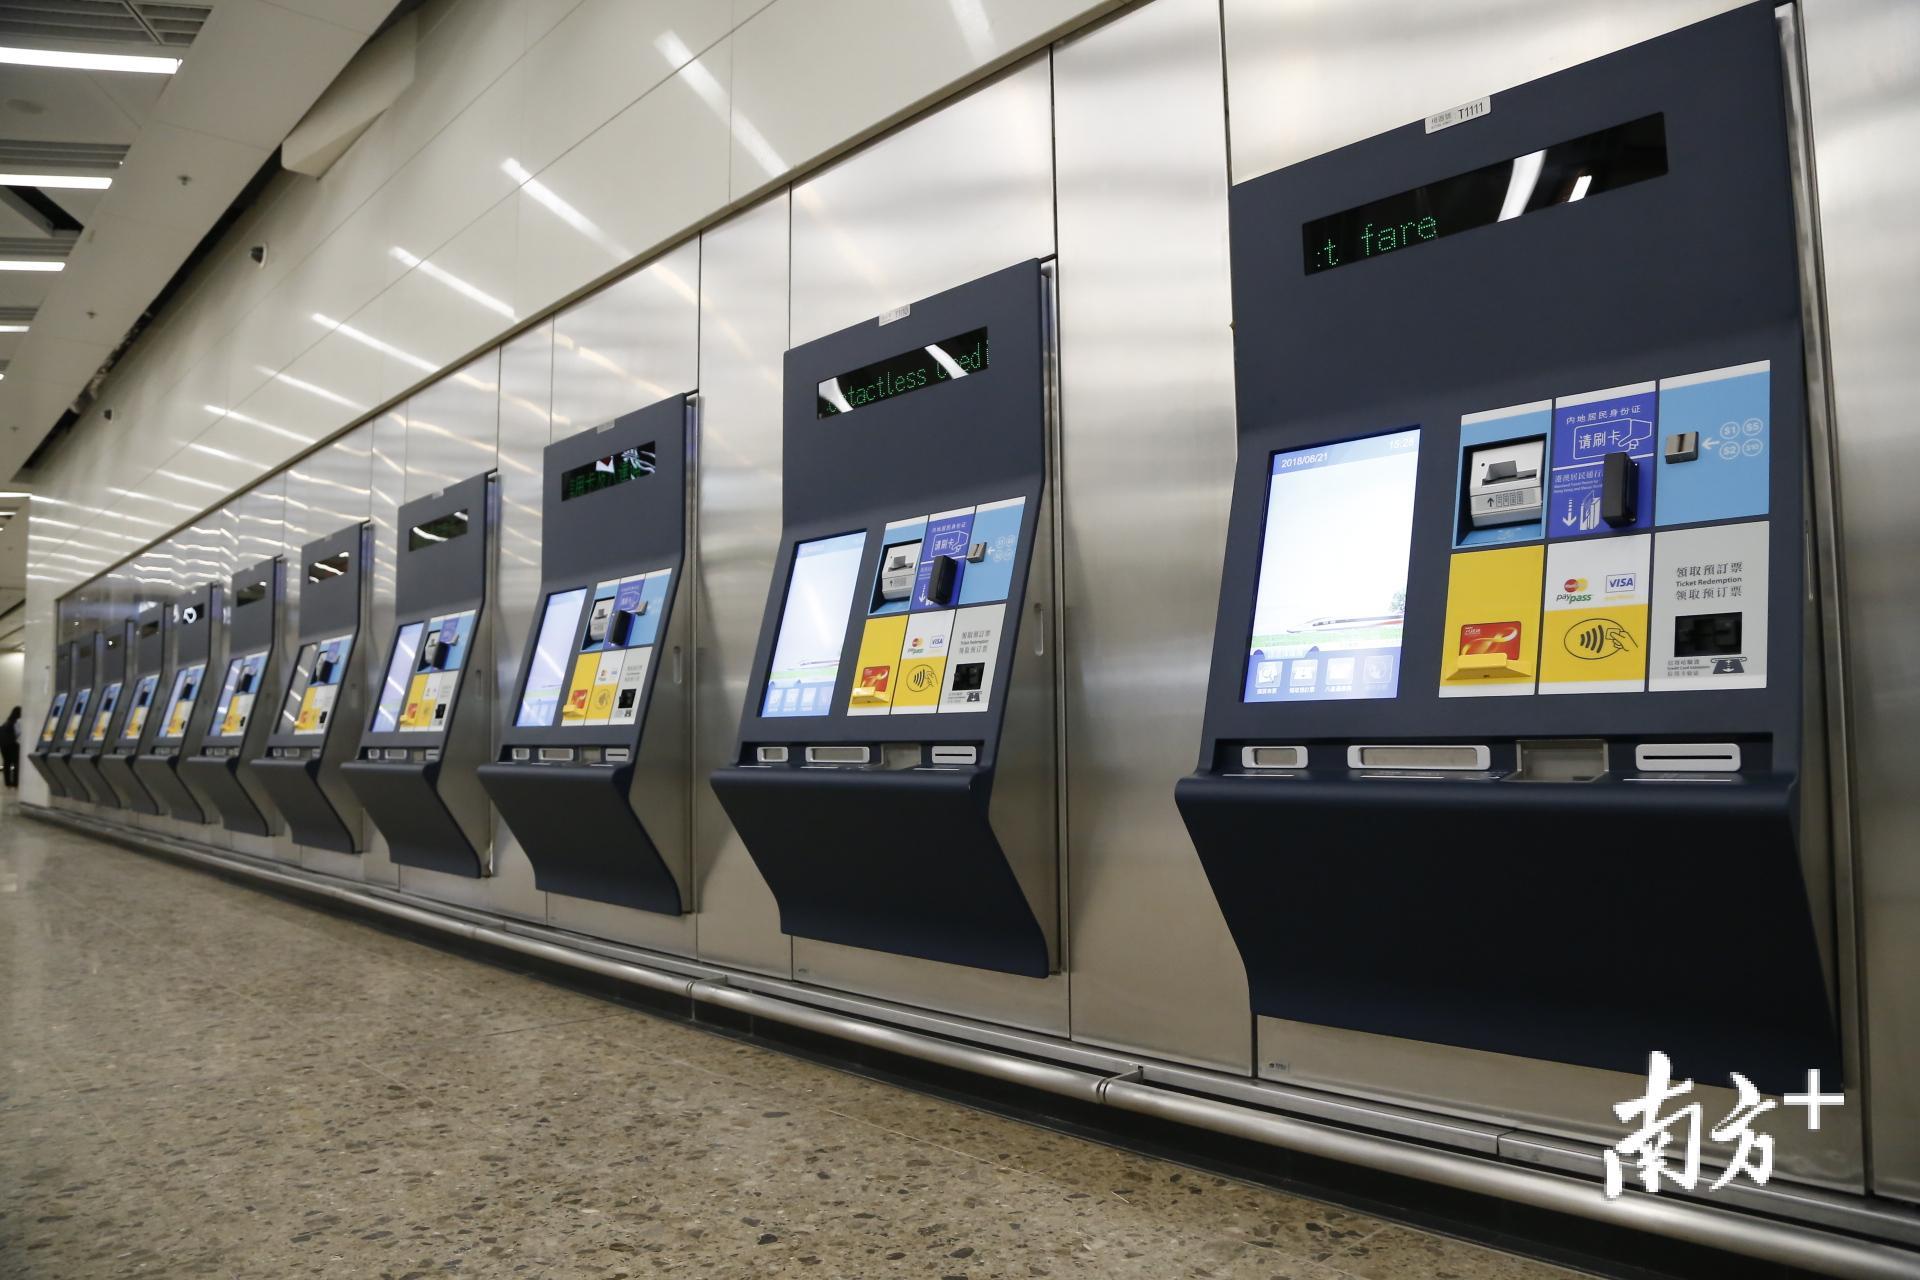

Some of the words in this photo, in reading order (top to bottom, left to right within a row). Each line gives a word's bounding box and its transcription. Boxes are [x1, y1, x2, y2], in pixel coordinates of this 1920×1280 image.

[1458, 102, 1484, 120] T1111
[1361, 215, 1437, 256] fare
[1579, 429, 1621, 449] 请刷卡
[1609, 577, 1635, 588] VISA
[1698, 577, 1743, 586] Redemption
